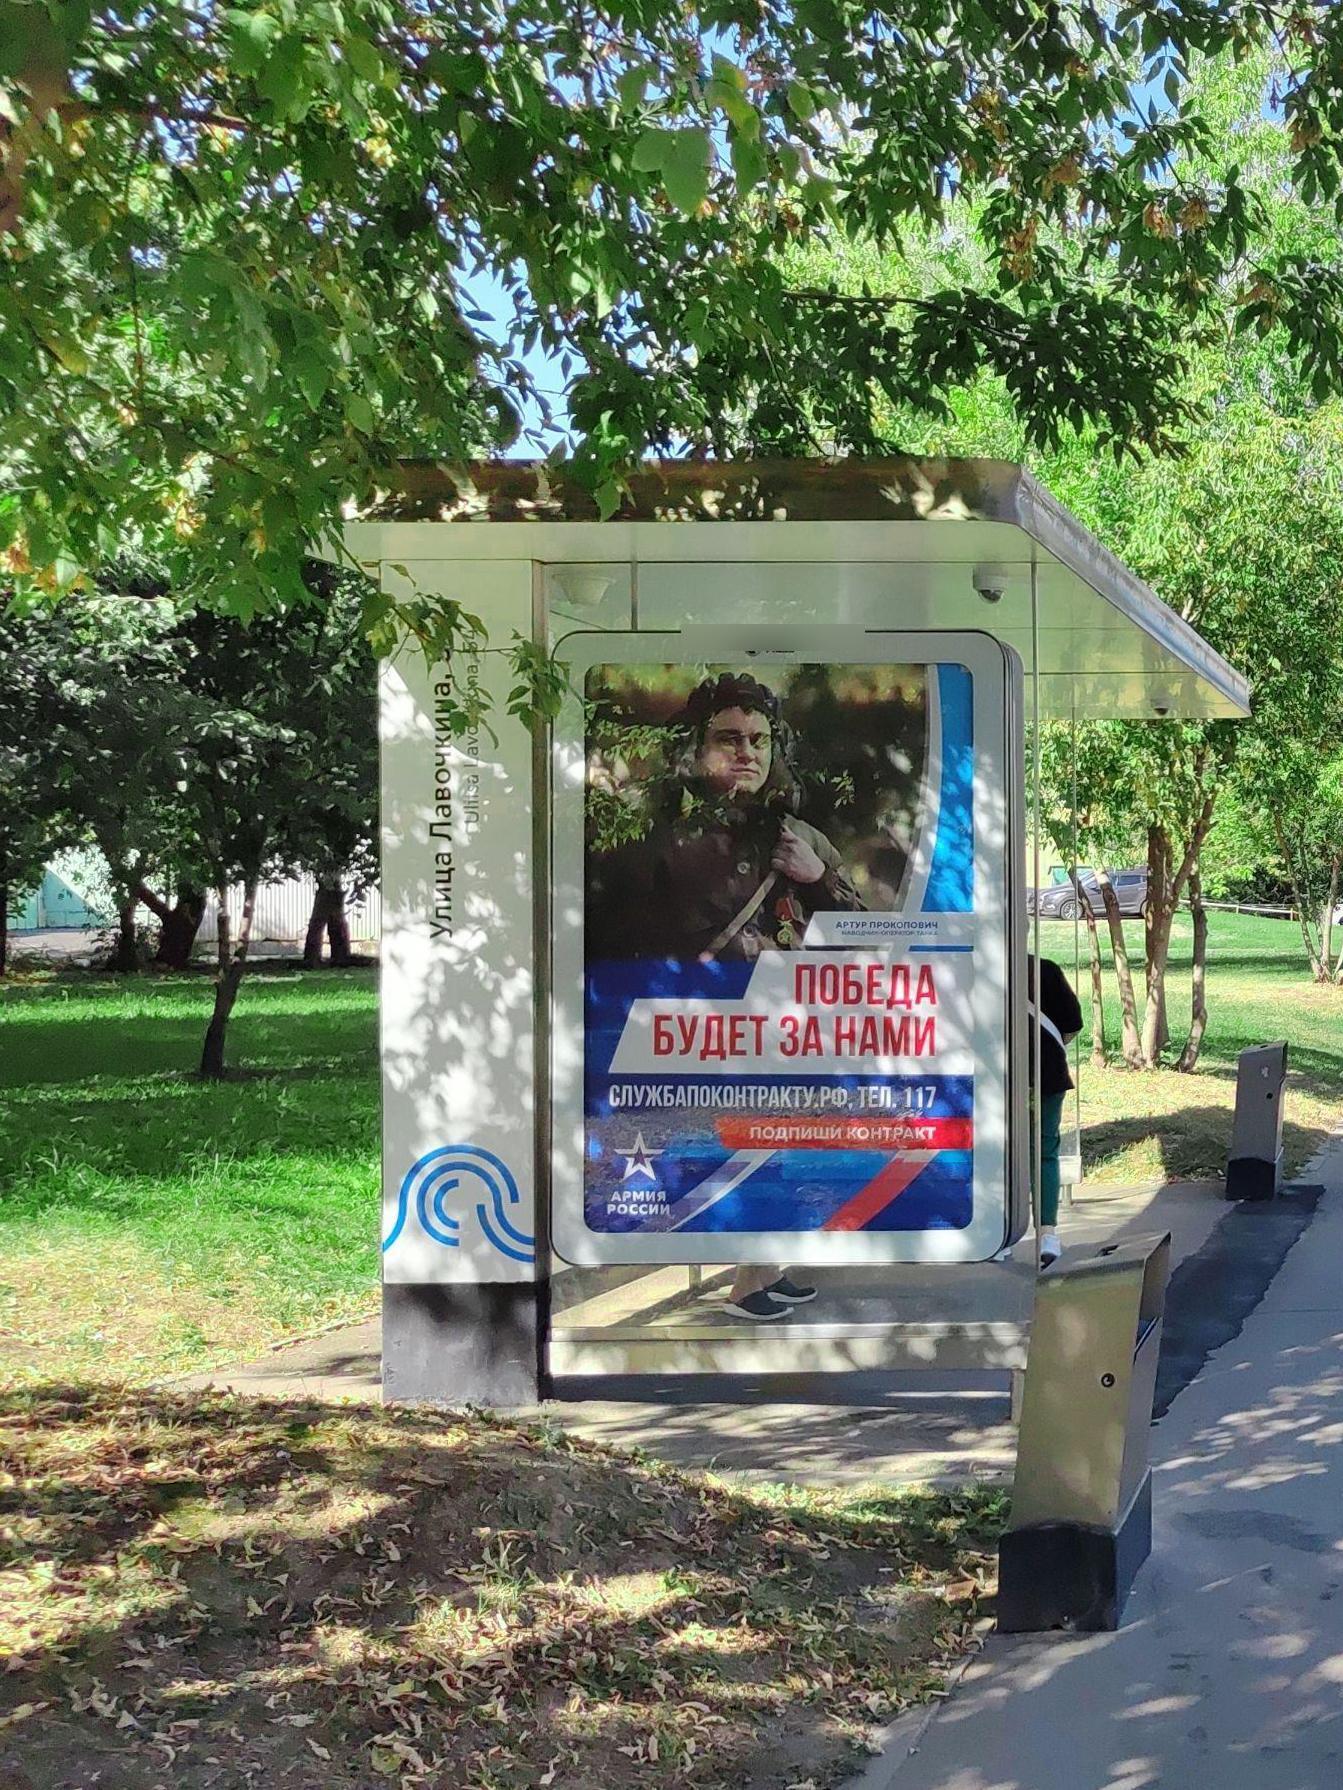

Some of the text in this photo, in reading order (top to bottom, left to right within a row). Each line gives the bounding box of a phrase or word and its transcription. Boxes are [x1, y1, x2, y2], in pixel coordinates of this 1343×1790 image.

[429, 673, 453, 842] Лавочкина,
[429, 851, 455, 940] Улица
[836, 921, 938, 929] АРТУР ПРОКОПОВИЧ
[794, 963, 938, 1010] ПОБЕДА
[653, 1015, 936, 1061] БУДЕТ ЗА НАМИ
[608, 1084, 938, 1112] СЛУЖБАПОКОНТРАКТУ.РФ, ТЕЛ. 117
[750, 1124, 937, 1142] ПОДПИШИ КОНТРАКТ
[607, 1203, 671, 1216] РОССИИ
[611, 1190, 667, 1203] АРМИЯ
